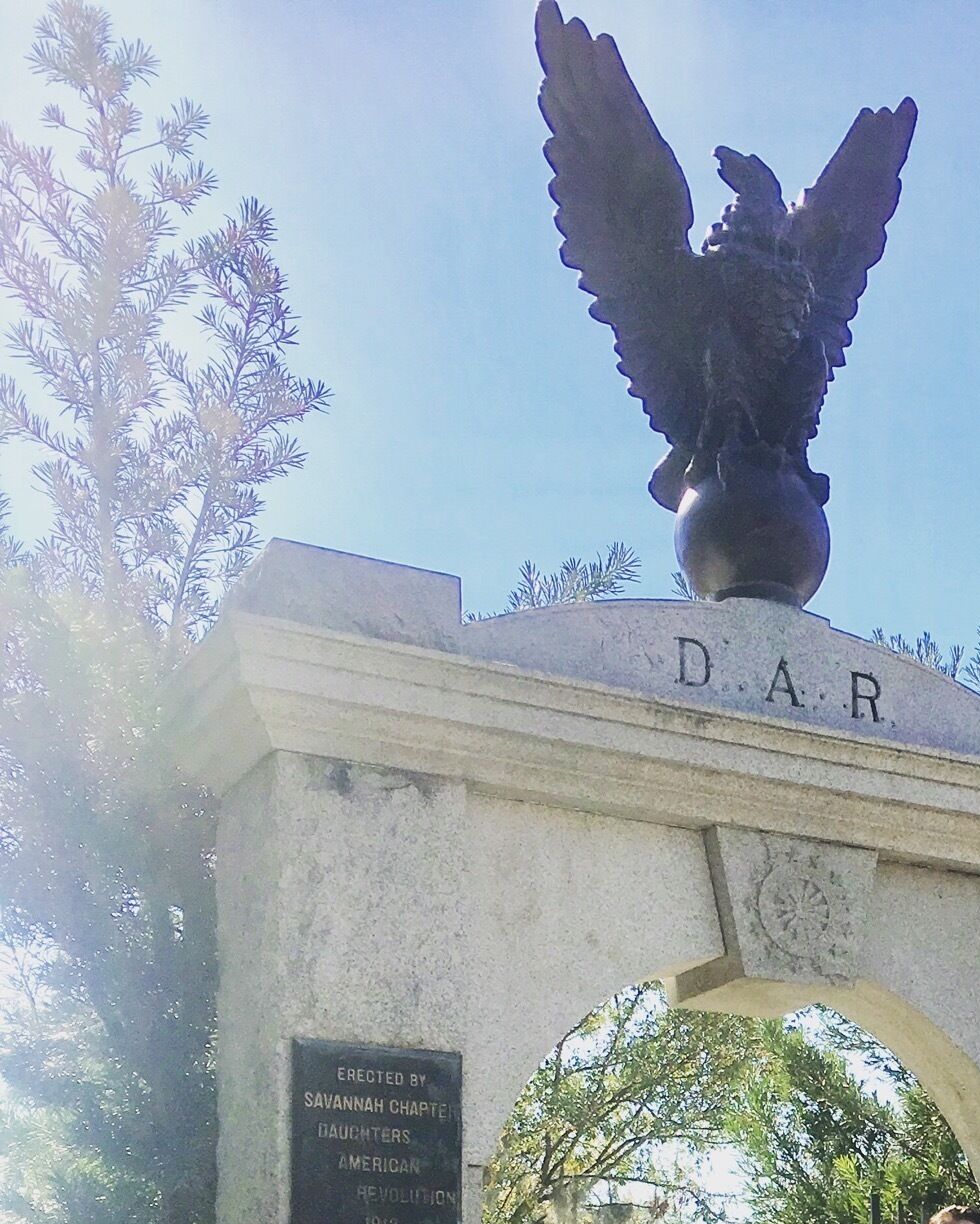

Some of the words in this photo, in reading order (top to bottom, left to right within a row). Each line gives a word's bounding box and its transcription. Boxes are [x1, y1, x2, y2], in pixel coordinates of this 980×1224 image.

[337, 1066, 404, 1086] ERECTED
[410, 1073, 426, 1088] BY
[304, 1091, 384, 1114] SAVANNAH
[338, 1152, 421, 1175] AMERICAN
[357, 1184, 457, 1207] REVOLUTION
